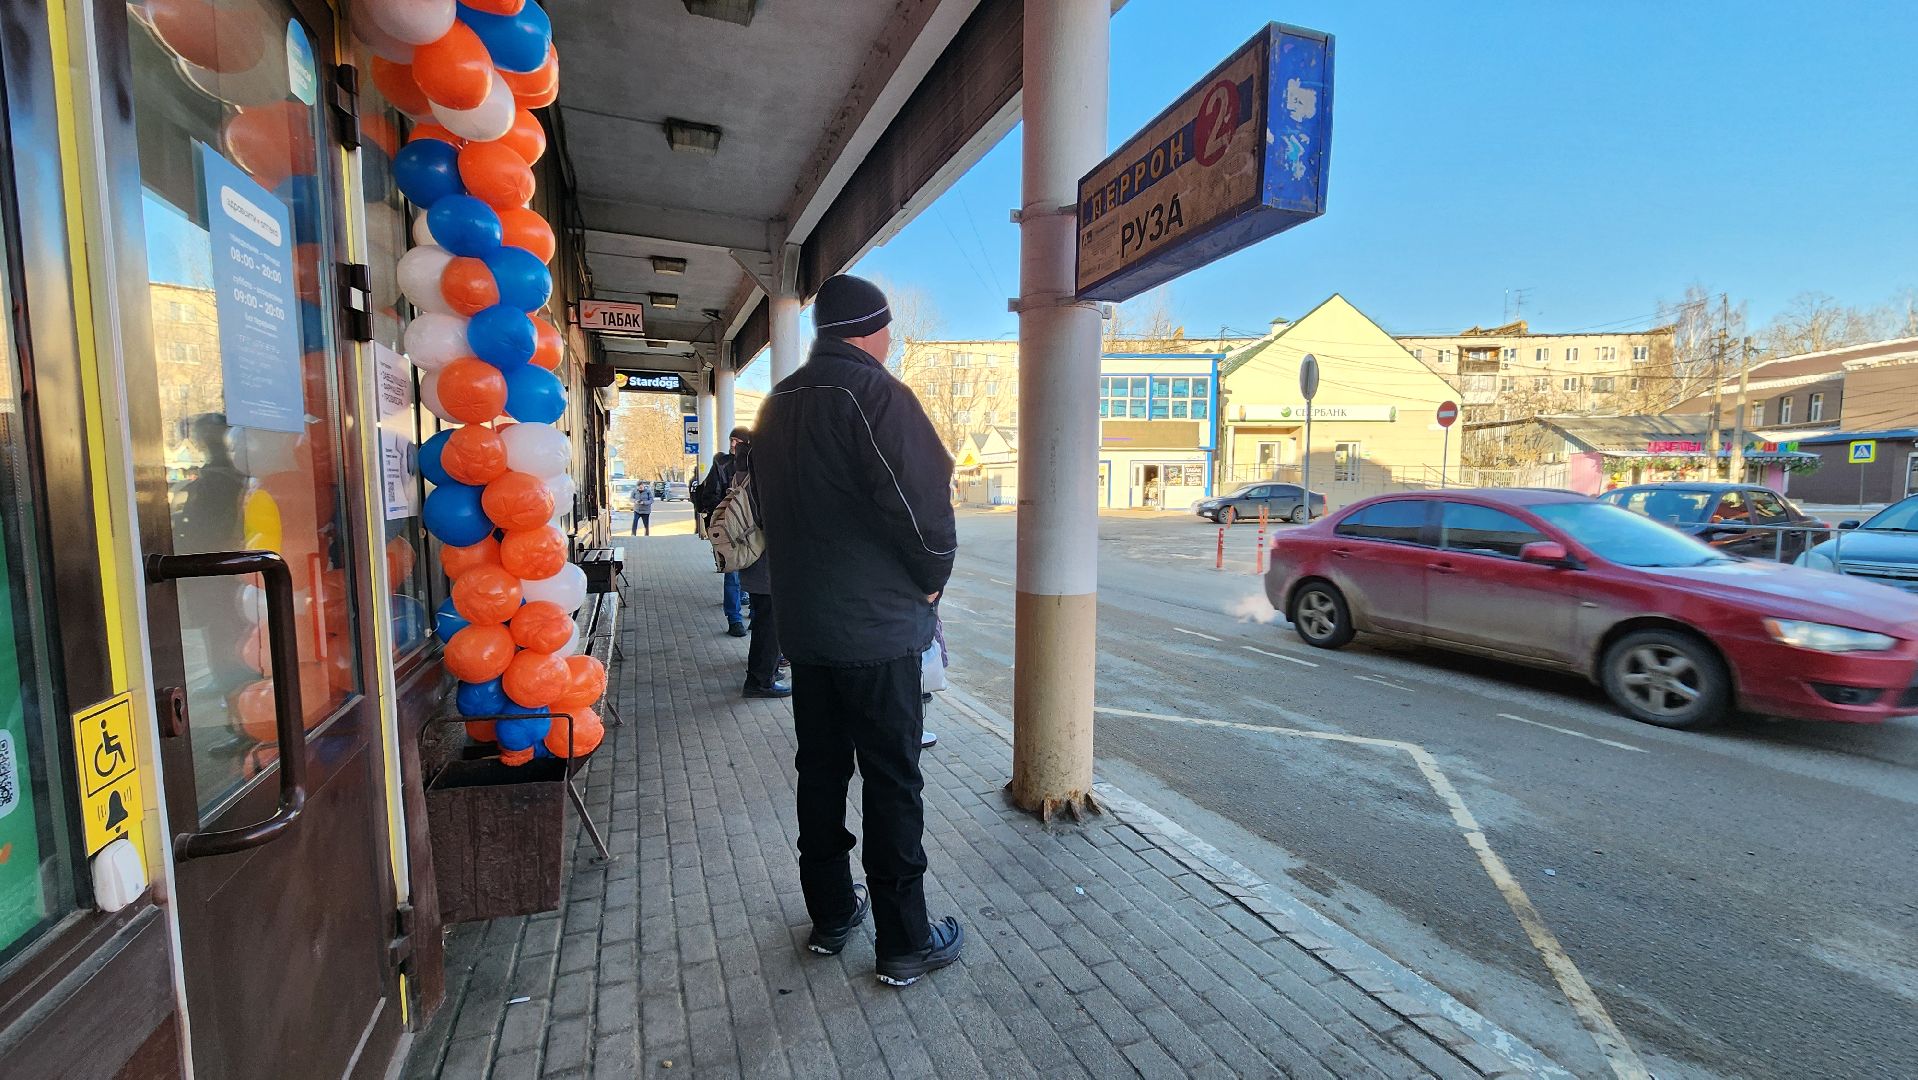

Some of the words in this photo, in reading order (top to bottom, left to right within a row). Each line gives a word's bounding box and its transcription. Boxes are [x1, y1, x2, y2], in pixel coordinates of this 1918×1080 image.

[1092, 132, 1185, 221] ПЕРРОН
[1203, 86, 1231, 159] 2
[1121, 193, 1184, 259] РУЗА
[231, 246, 255, 270] 08:00
[261, 263, 282, 284] 20:00
[233, 287, 258, 309] 09:00
[264, 302, 285, 321] 20:00
[600, 311, 641, 327] ТАБАК
[629, 376, 680, 389] Stardogs
[1647, 440, 1701, 452] ЦВЕТЫ
